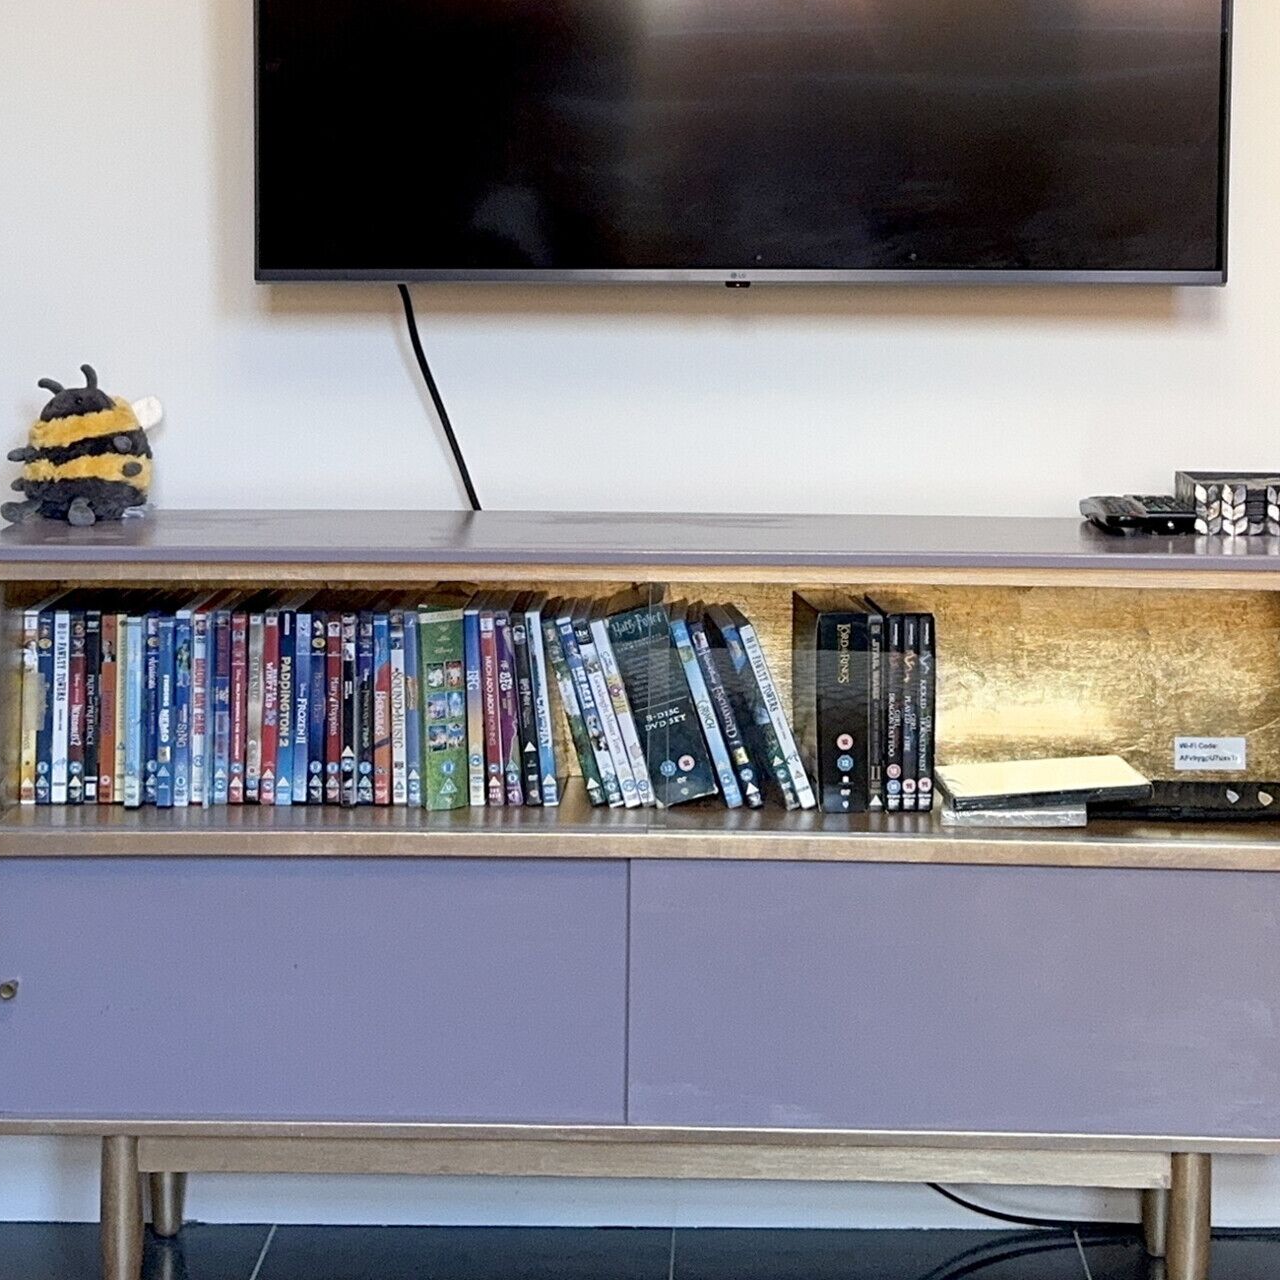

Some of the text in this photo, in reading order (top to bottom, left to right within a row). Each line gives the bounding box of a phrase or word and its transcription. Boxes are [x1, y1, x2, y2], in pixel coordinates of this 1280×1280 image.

[612, 612, 662, 637] Harry Potter
[56, 642, 67, 670] FAWLTY
[485, 656, 493, 677] MUCH
[837, 623, 851, 684] LORD RINGS
[872, 638, 880, 670] STAR
[56, 673, 67, 702] TOWERS
[86, 674, 95, 696] PRIDE
[265, 662, 274, 709] WIMPY KID
[467, 670, 479, 691] BFG
[872, 670, 880, 700] WARS
[194, 658, 206, 736] DADDY DAY CARE
[278, 656, 292, 747] PADDINGTON 2
[328, 677, 339, 736] Mary Poppins
[392, 671, 405, 749] SOUND MUSIC
[487, 693, 495, 715] ABOUT
[536, 696, 546, 718] CAT
[762, 683, 779, 713] TOWERS
[86, 705, 95, 745] PREJUDICE
[159, 708, 170, 743] NEMO
[297, 698, 308, 735] FROZEN
[375, 691, 388, 737] HERCULES
[645, 714, 687, 732] DVD SET
[697, 700, 715, 729] GRINCH
[711, 686, 738, 739] ENCHANTED
[176, 723, 188, 748] SING
